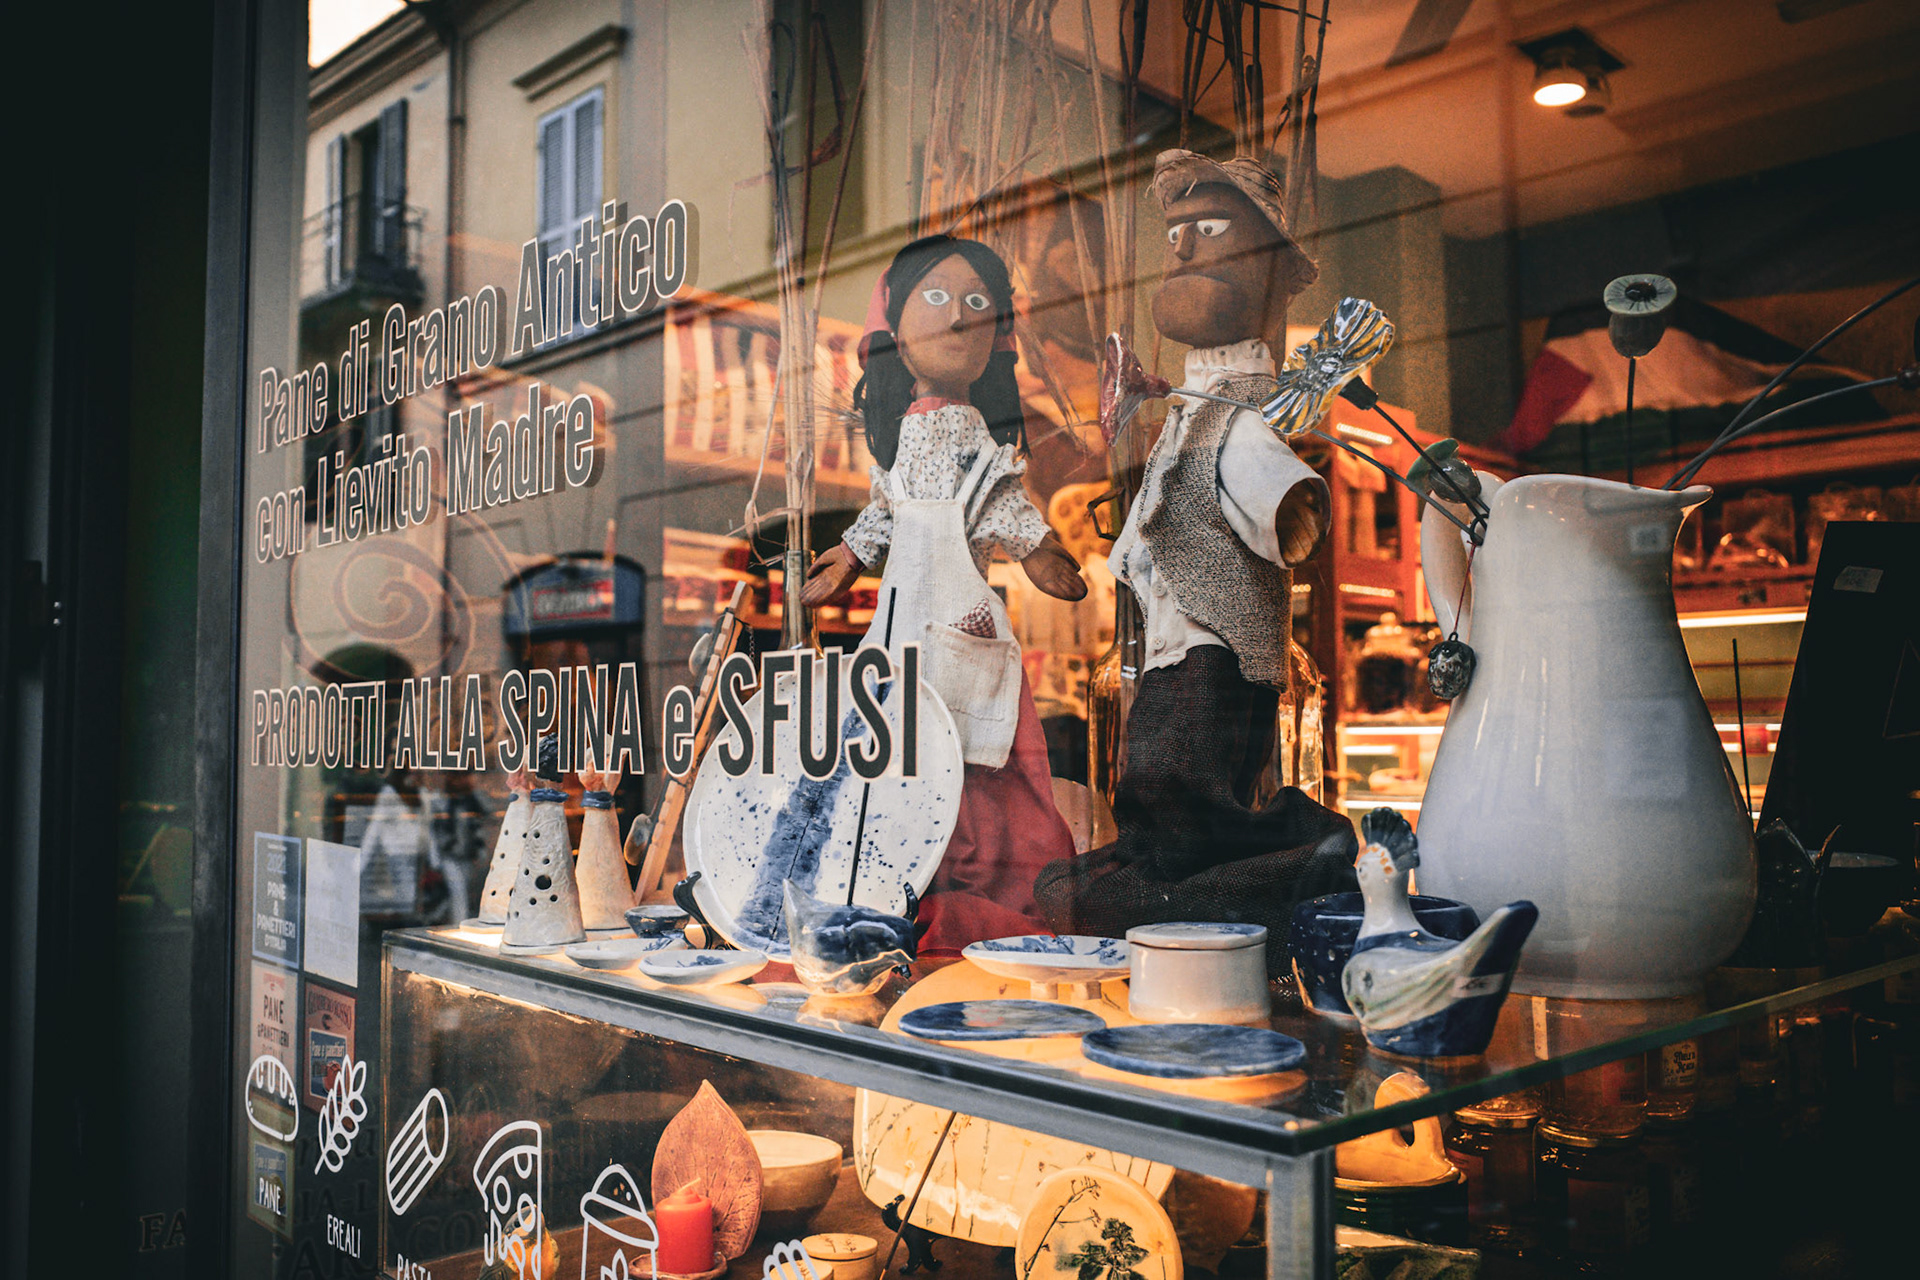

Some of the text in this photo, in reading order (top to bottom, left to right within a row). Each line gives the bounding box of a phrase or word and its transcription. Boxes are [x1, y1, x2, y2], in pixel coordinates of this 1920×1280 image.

[257, 198, 687, 454] Pane di Grano Antico
[256, 381, 595, 564] con Lievito Madre
[250, 640, 923, 781] PRODOTTI ALLA SPINA e SFUSI
[263, 994, 285, 1025] PANE
[259, 1176, 282, 1216] PANE
[327, 1213, 361, 1259] EREALI
[396, 1252, 432, 1280] PAS
